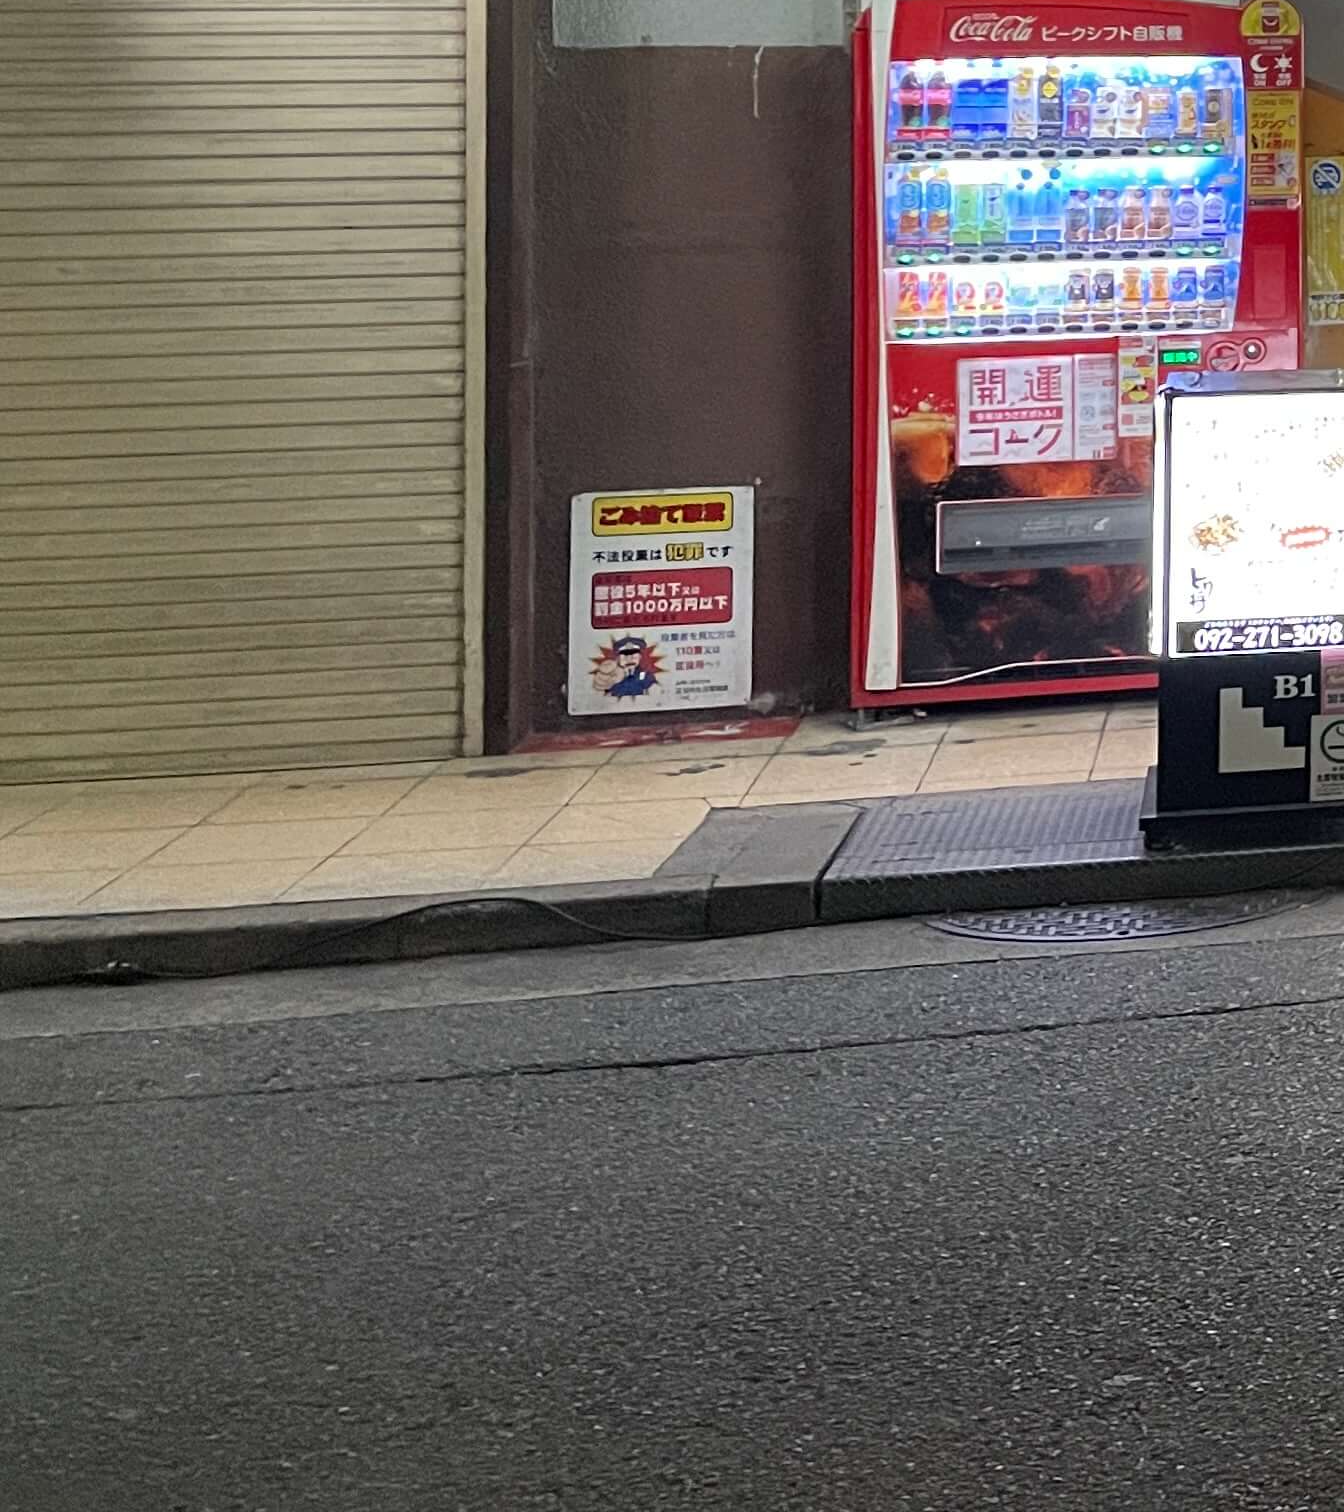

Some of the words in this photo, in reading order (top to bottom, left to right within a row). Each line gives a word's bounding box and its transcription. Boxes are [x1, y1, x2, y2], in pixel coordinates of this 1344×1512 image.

[1041, 25, 1183, 42] ピークシフト自販機
[970, 365, 1063, 406] 開運
[969, 423, 1063, 456] コーク
[1194, 620, 1344, 652] 092-271-3098
[1273, 674, 1316, 699] B1
